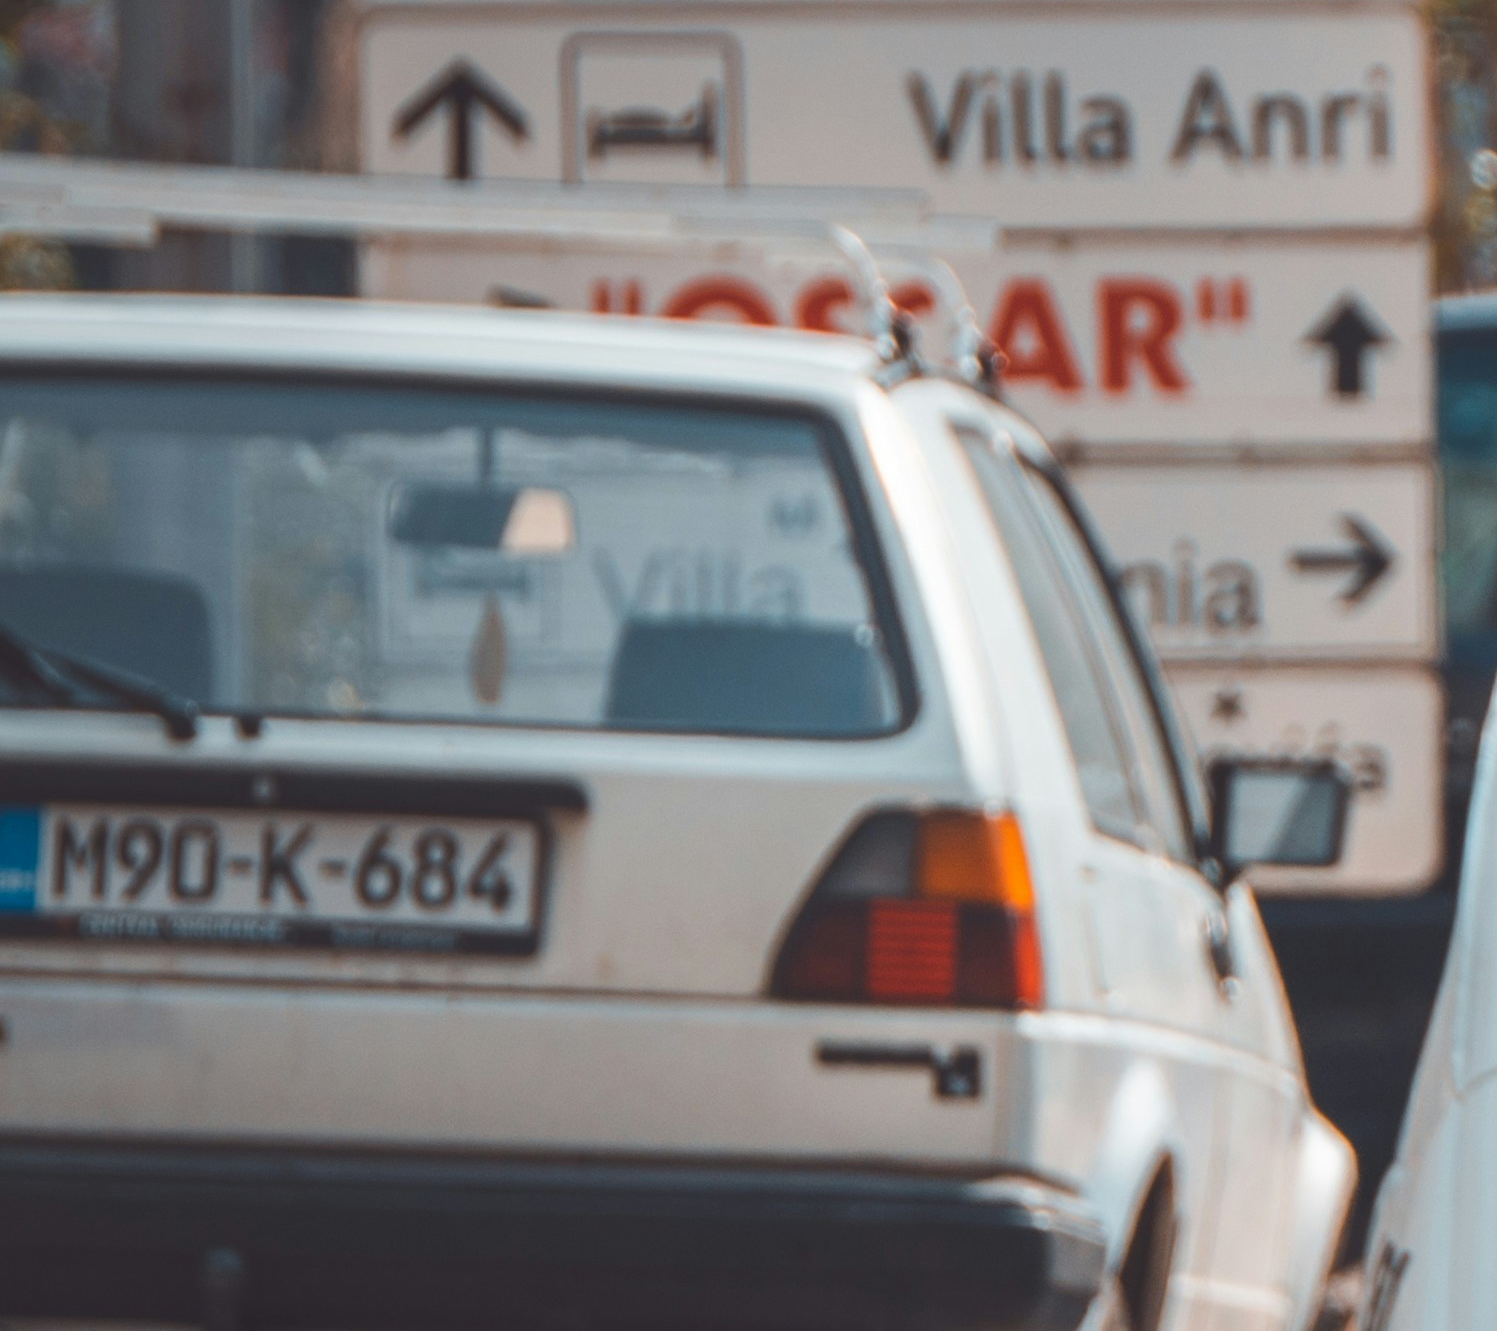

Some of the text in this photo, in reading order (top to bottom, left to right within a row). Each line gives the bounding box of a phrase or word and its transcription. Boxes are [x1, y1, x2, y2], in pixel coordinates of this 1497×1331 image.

[906, 65, 1394, 169] Villa Anri
[50, 813, 516, 915] M90-K-684
